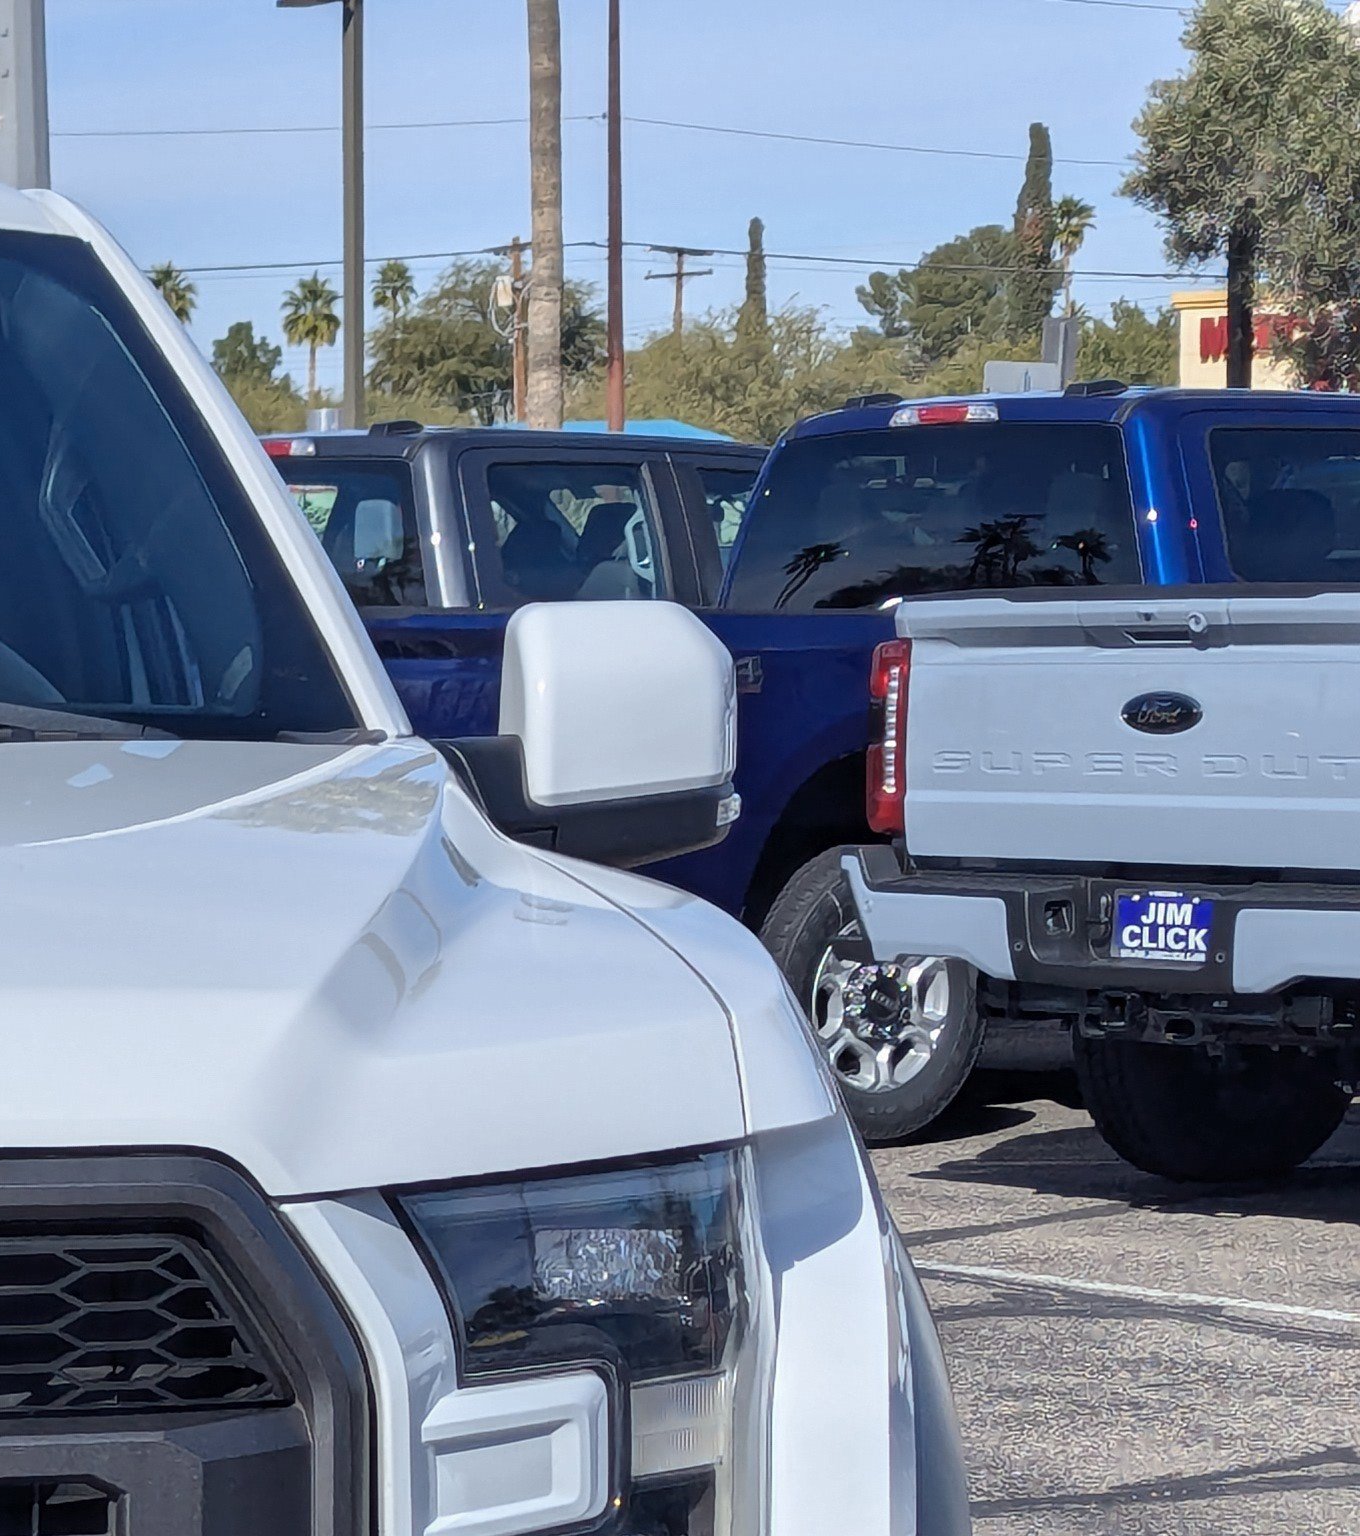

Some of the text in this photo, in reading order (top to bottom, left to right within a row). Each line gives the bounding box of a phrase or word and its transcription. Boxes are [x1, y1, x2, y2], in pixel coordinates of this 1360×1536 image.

[932, 750, 1178, 778] SUPER
[1140, 902, 1193, 926] JIM
[1122, 925, 1208, 952] CLICK
